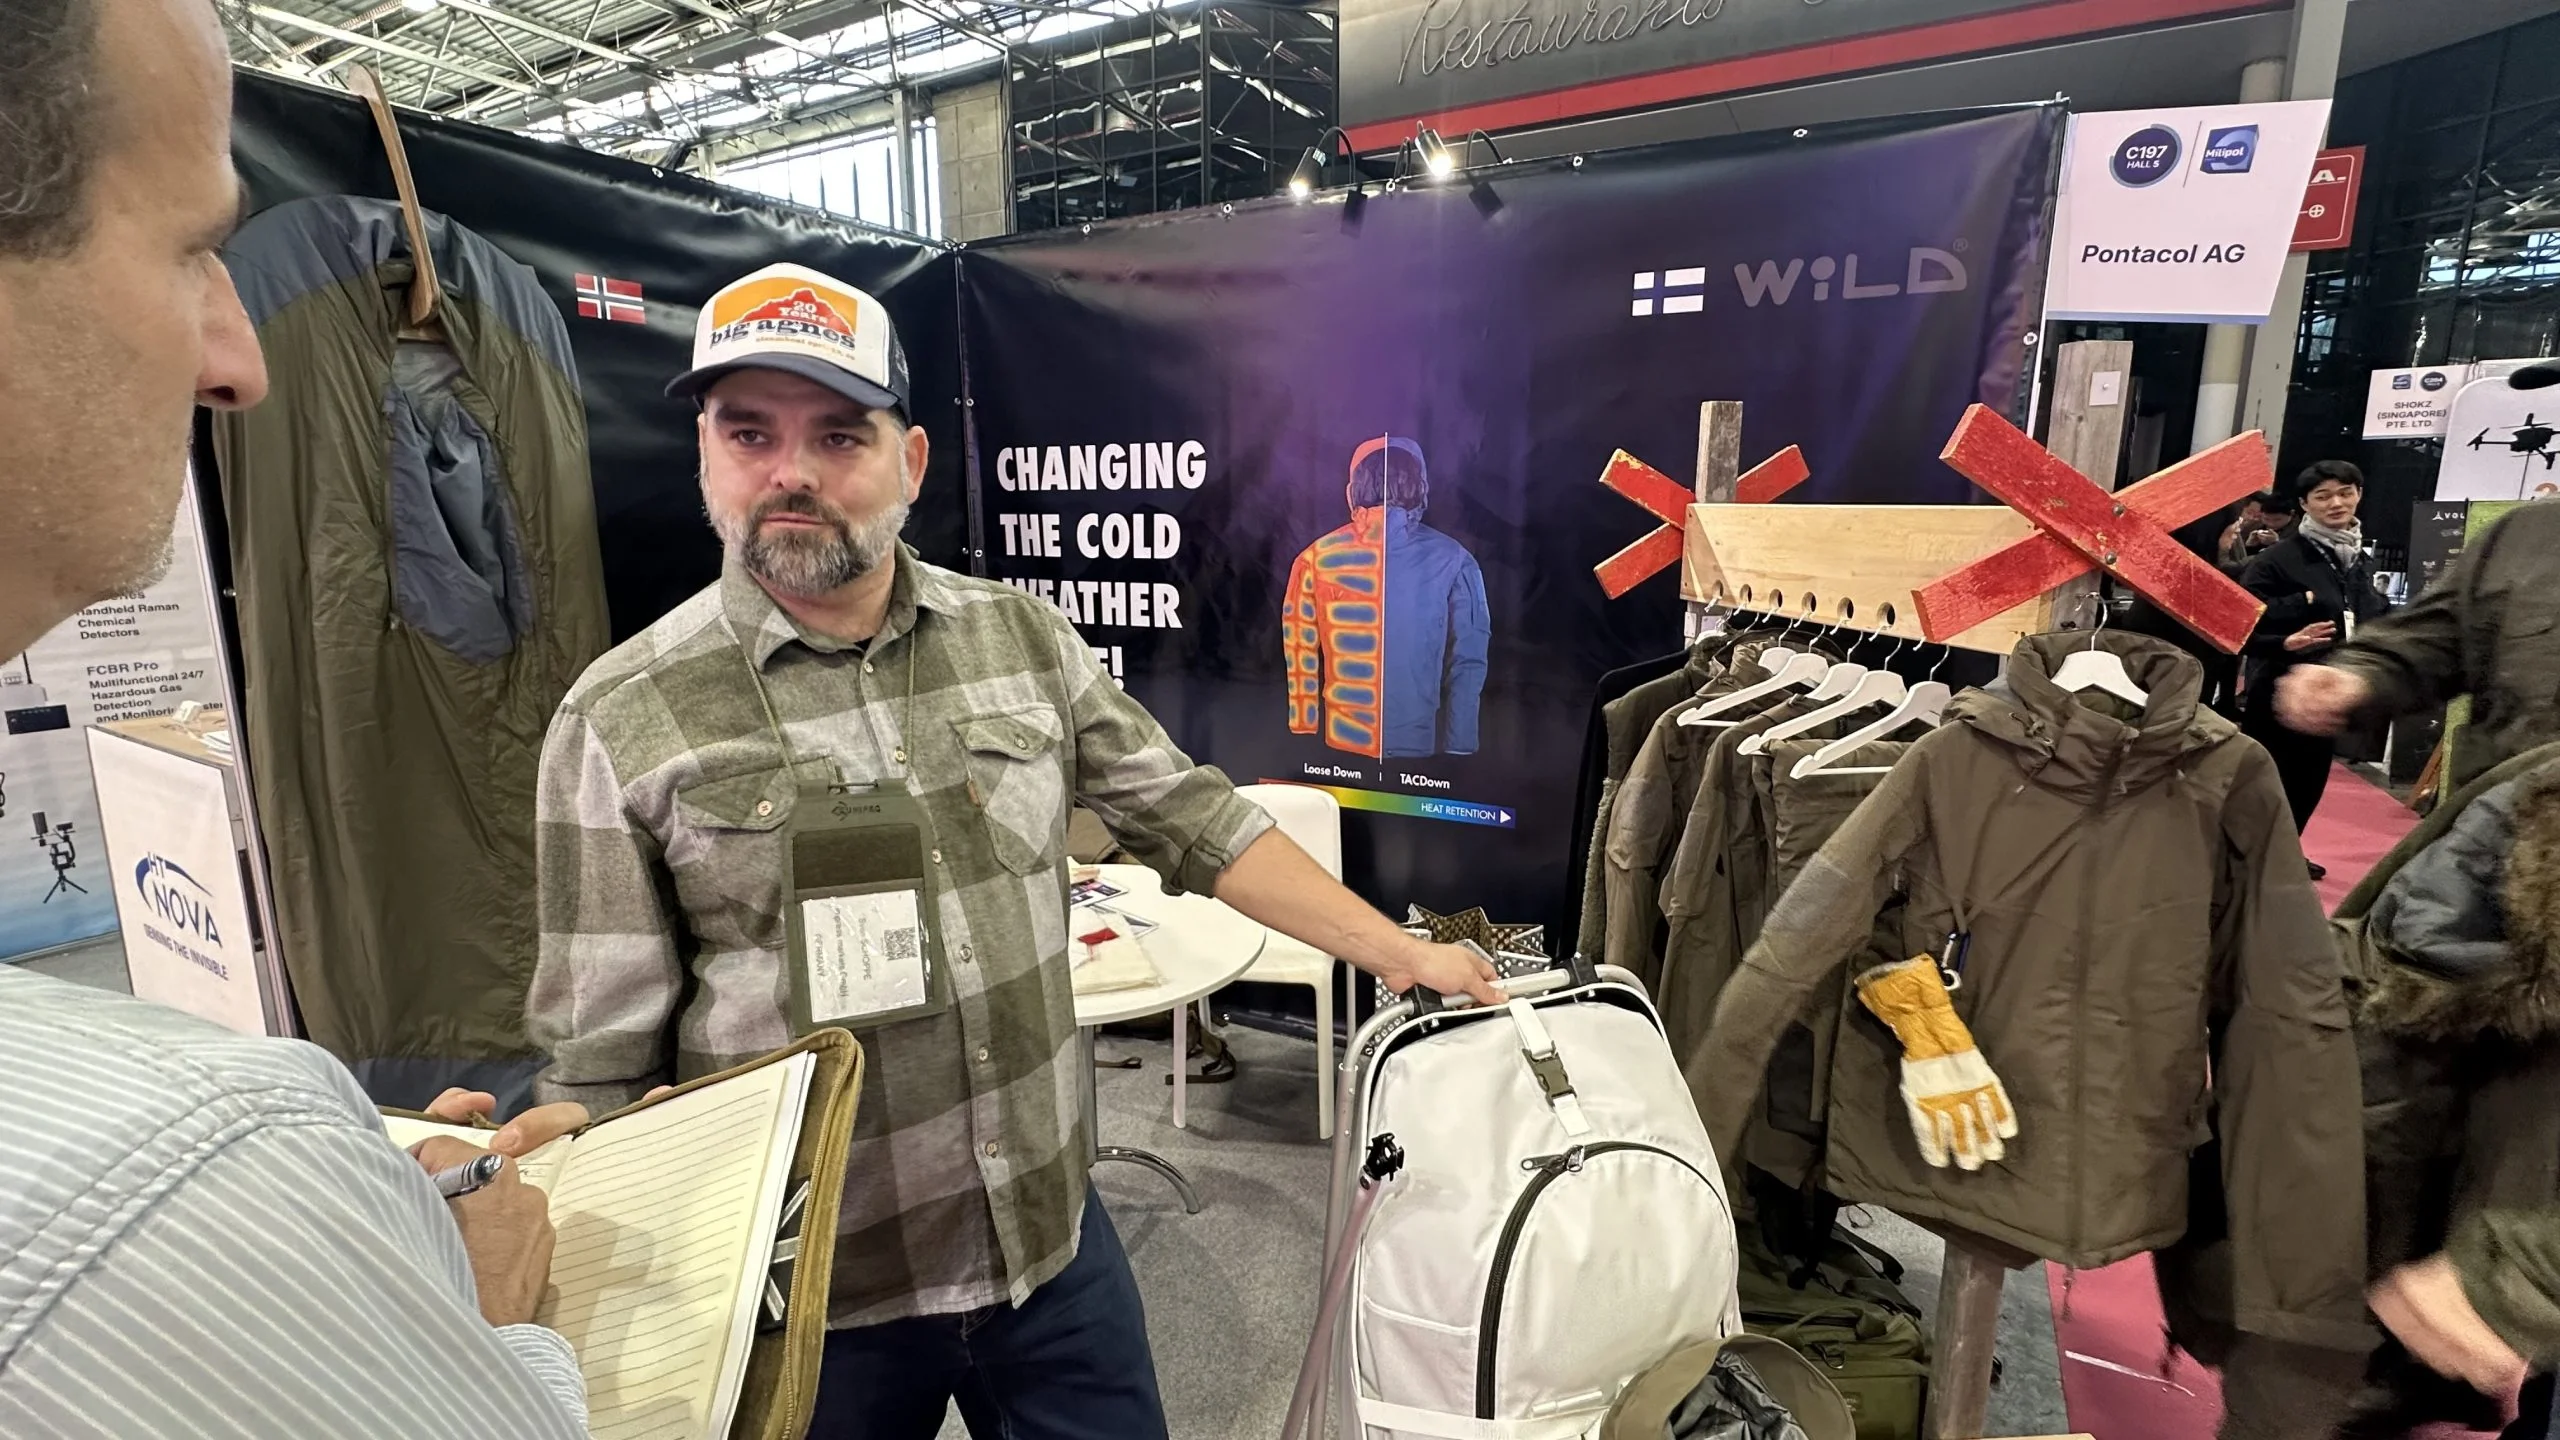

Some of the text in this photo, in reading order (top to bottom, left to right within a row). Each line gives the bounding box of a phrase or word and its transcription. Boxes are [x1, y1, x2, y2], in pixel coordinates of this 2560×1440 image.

[2126, 145, 2168, 159] C197
[2205, 146, 2245, 158] Milipol
[2126, 159, 2160, 168] HALL 5
[2081, 244, 2246, 263] Pontacol AG
[793, 300, 818, 314] 20
[778, 306, 829, 324] Years
[710, 322, 751, 349] big
[756, 319, 856, 351] agnes
[2394, 401, 2432, 409] SHOKZ
[2377, 409, 2447, 420] (SINGAPORE)
[997, 440, 1207, 491] CHANGING
[1000, 512, 1181, 559] THE COLD
[138, 602, 180, 612] Raman
[78, 616, 136, 628] Chemical
[80, 628, 140, 639] Detectors
[86, 662, 159, 676] FCBR Pro
[89, 670, 204, 689] Multifunctional 24/7
[91, 684, 182, 700] Hazardous Gas
[94, 699, 152, 712] Detection
[96, 713, 119, 723] and
[1304, 762, 1362, 779] Loose Down
[1400, 773, 1450, 789] TACDown
[1421, 802, 1496, 820] HEAT RETENTION
[152, 880, 224, 949] NOVA
[173, 940, 190, 960] THE
